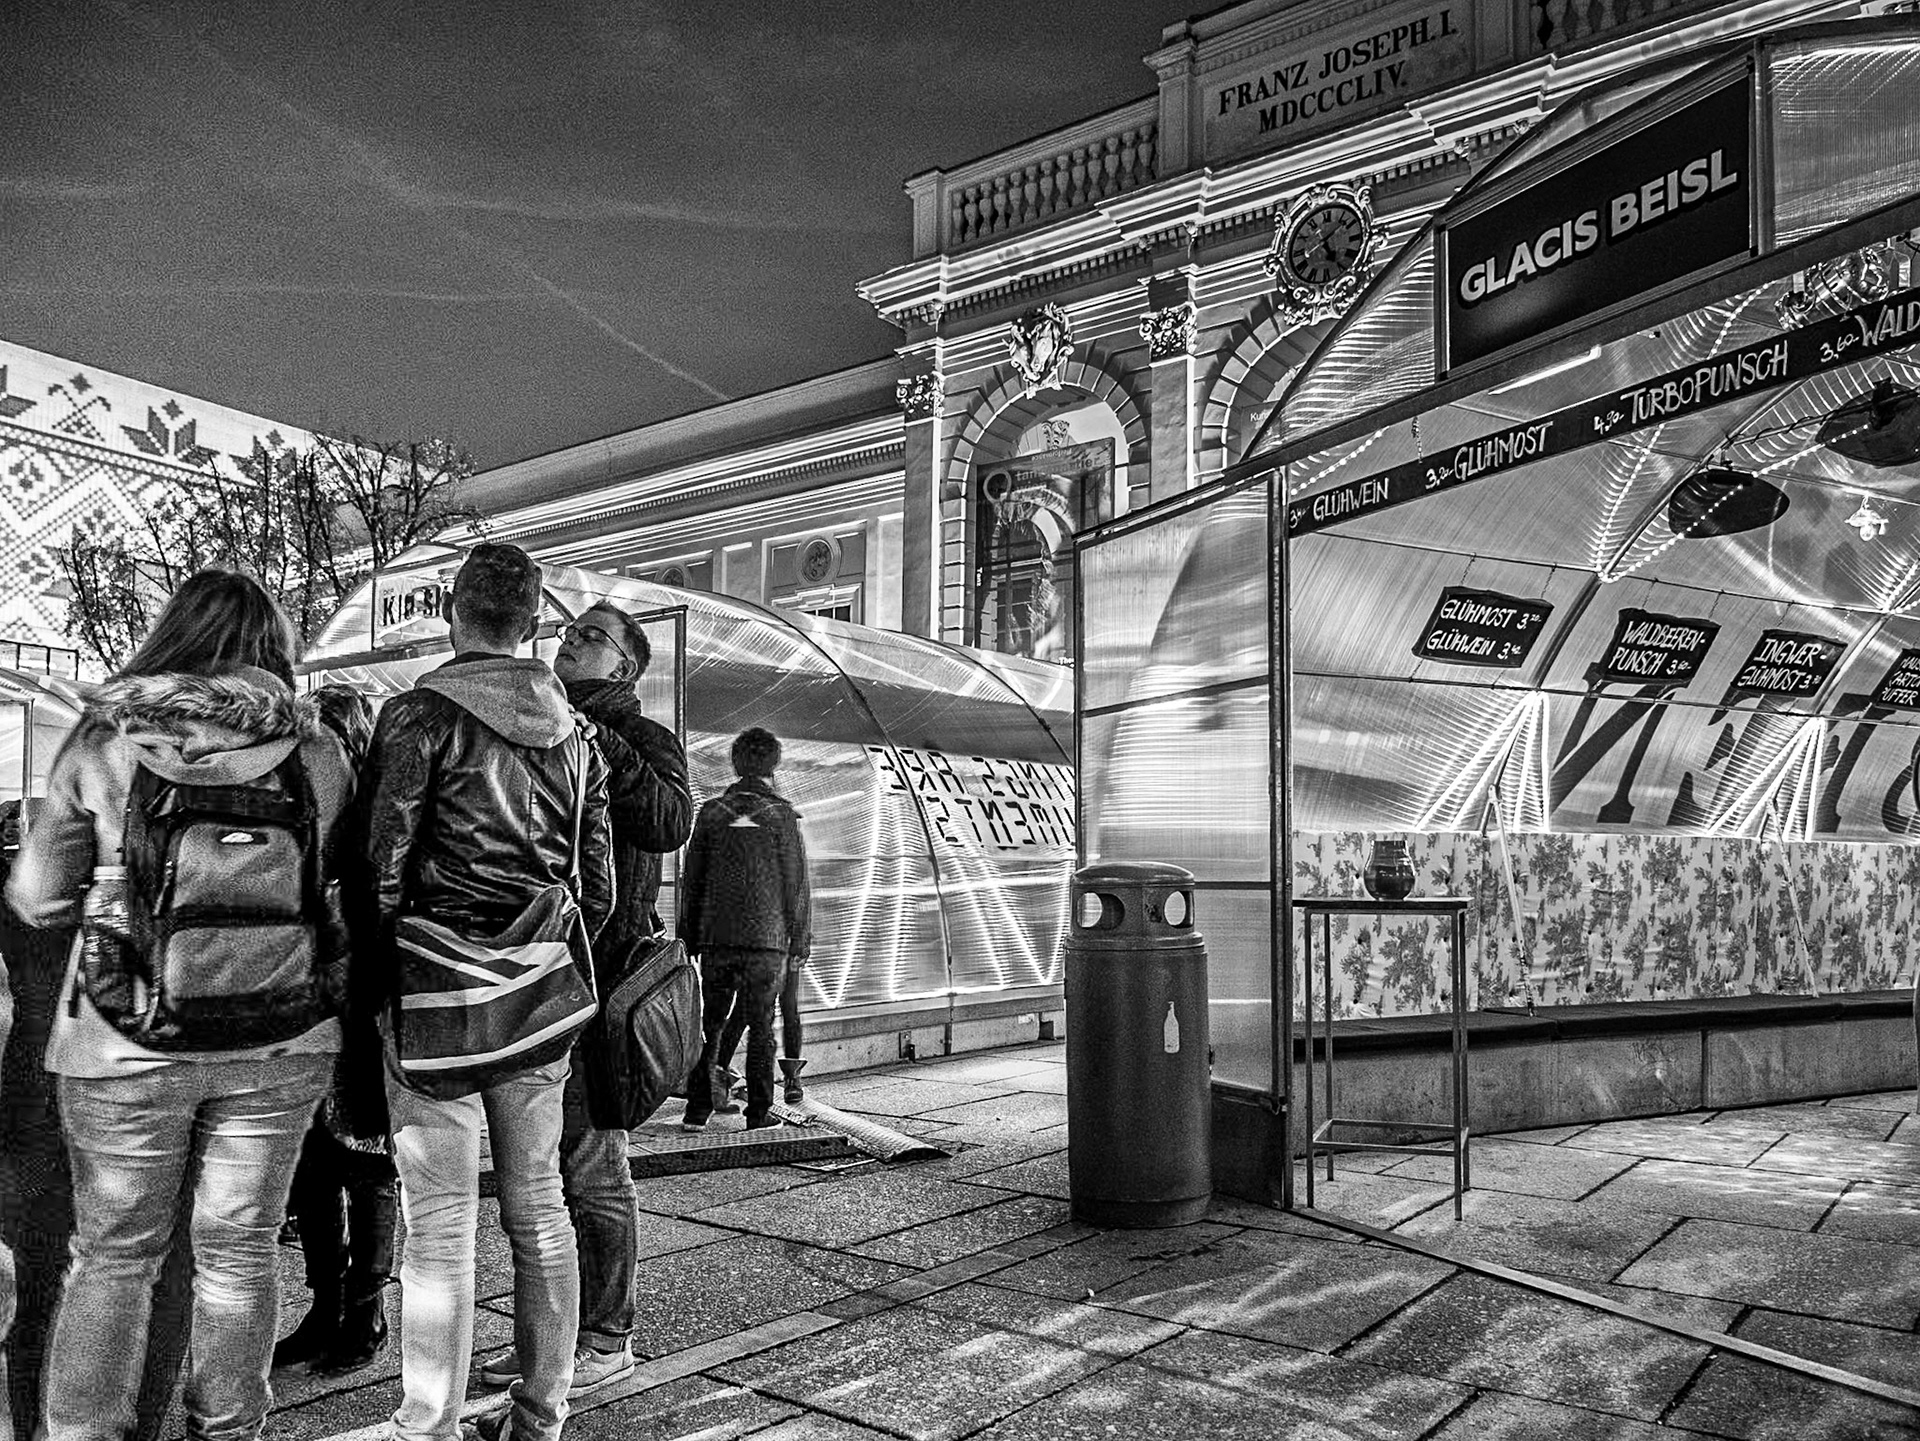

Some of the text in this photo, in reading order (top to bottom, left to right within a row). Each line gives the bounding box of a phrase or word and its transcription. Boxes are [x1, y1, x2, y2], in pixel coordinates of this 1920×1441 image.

[1218, 61, 1309, 116] FRANZ
[1259, 61, 1407, 134] MDCCCLIV.
[1460, 210, 1598, 302] GLACIS
[1611, 150, 1737, 237] BEISL
[1313, 478, 1389, 521] GLÜHWEIN
[1455, 421, 1553, 480] GLÜHMOST
[1620, 340, 1788, 424] TURBOPUNSCH
[1440, 599, 1517, 628] GLÜHMOST
[1427, 628, 1496, 655] GLÜHWEIN
[1621, 621, 1705, 651] WALDBEEREN-
[1608, 647, 1668, 675] PUNSCH
[1753, 638, 1827, 667] INGWER-
